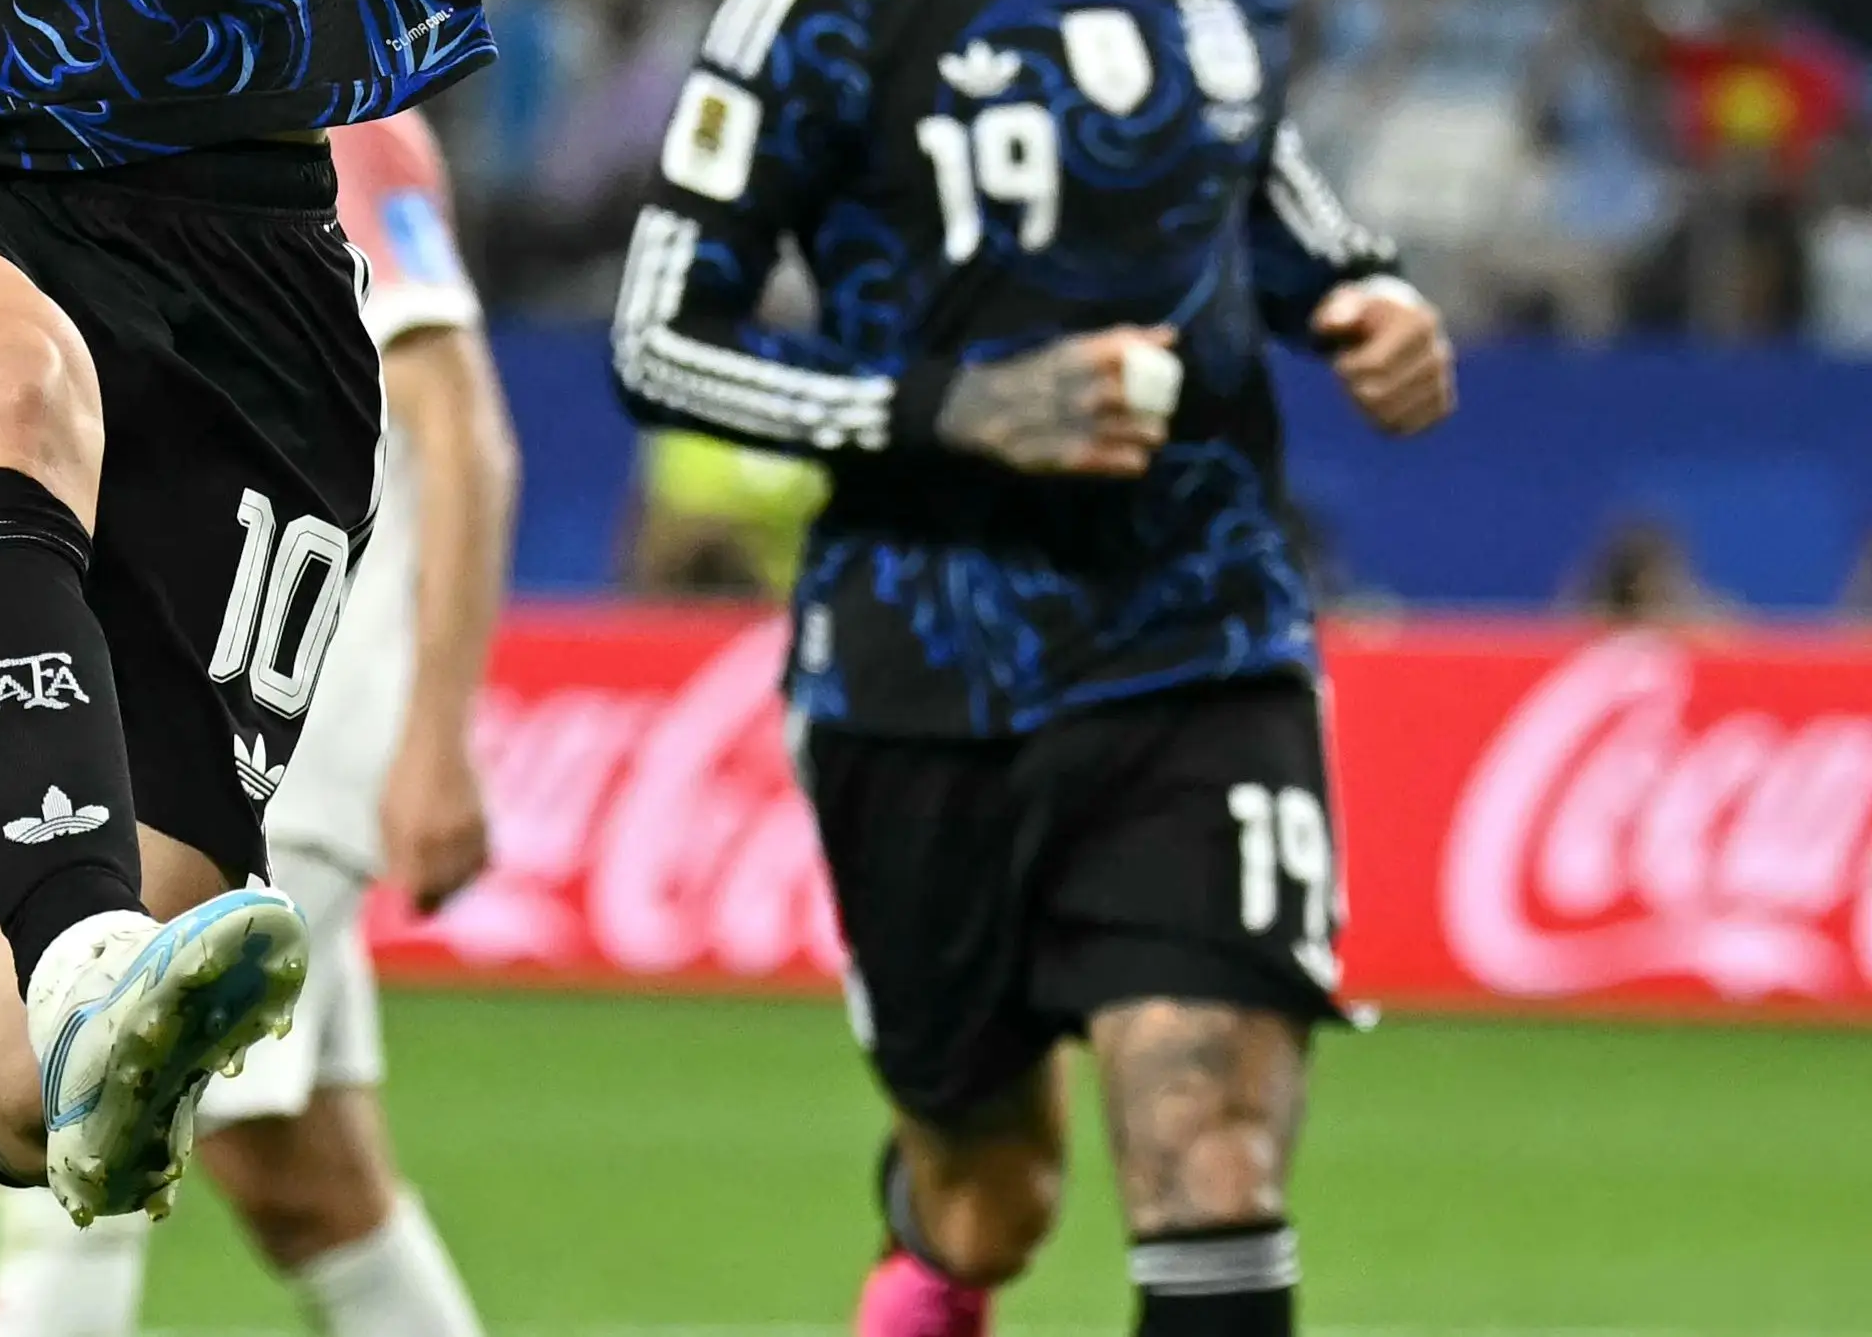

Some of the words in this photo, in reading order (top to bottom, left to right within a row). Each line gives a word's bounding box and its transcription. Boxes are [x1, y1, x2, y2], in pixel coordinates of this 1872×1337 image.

[390, 10, 451, 52] CLIMACOOL
[915, 102, 1061, 264] 19
[208, 487, 349, 720] 10
[1227, 782, 1332, 942] 19
